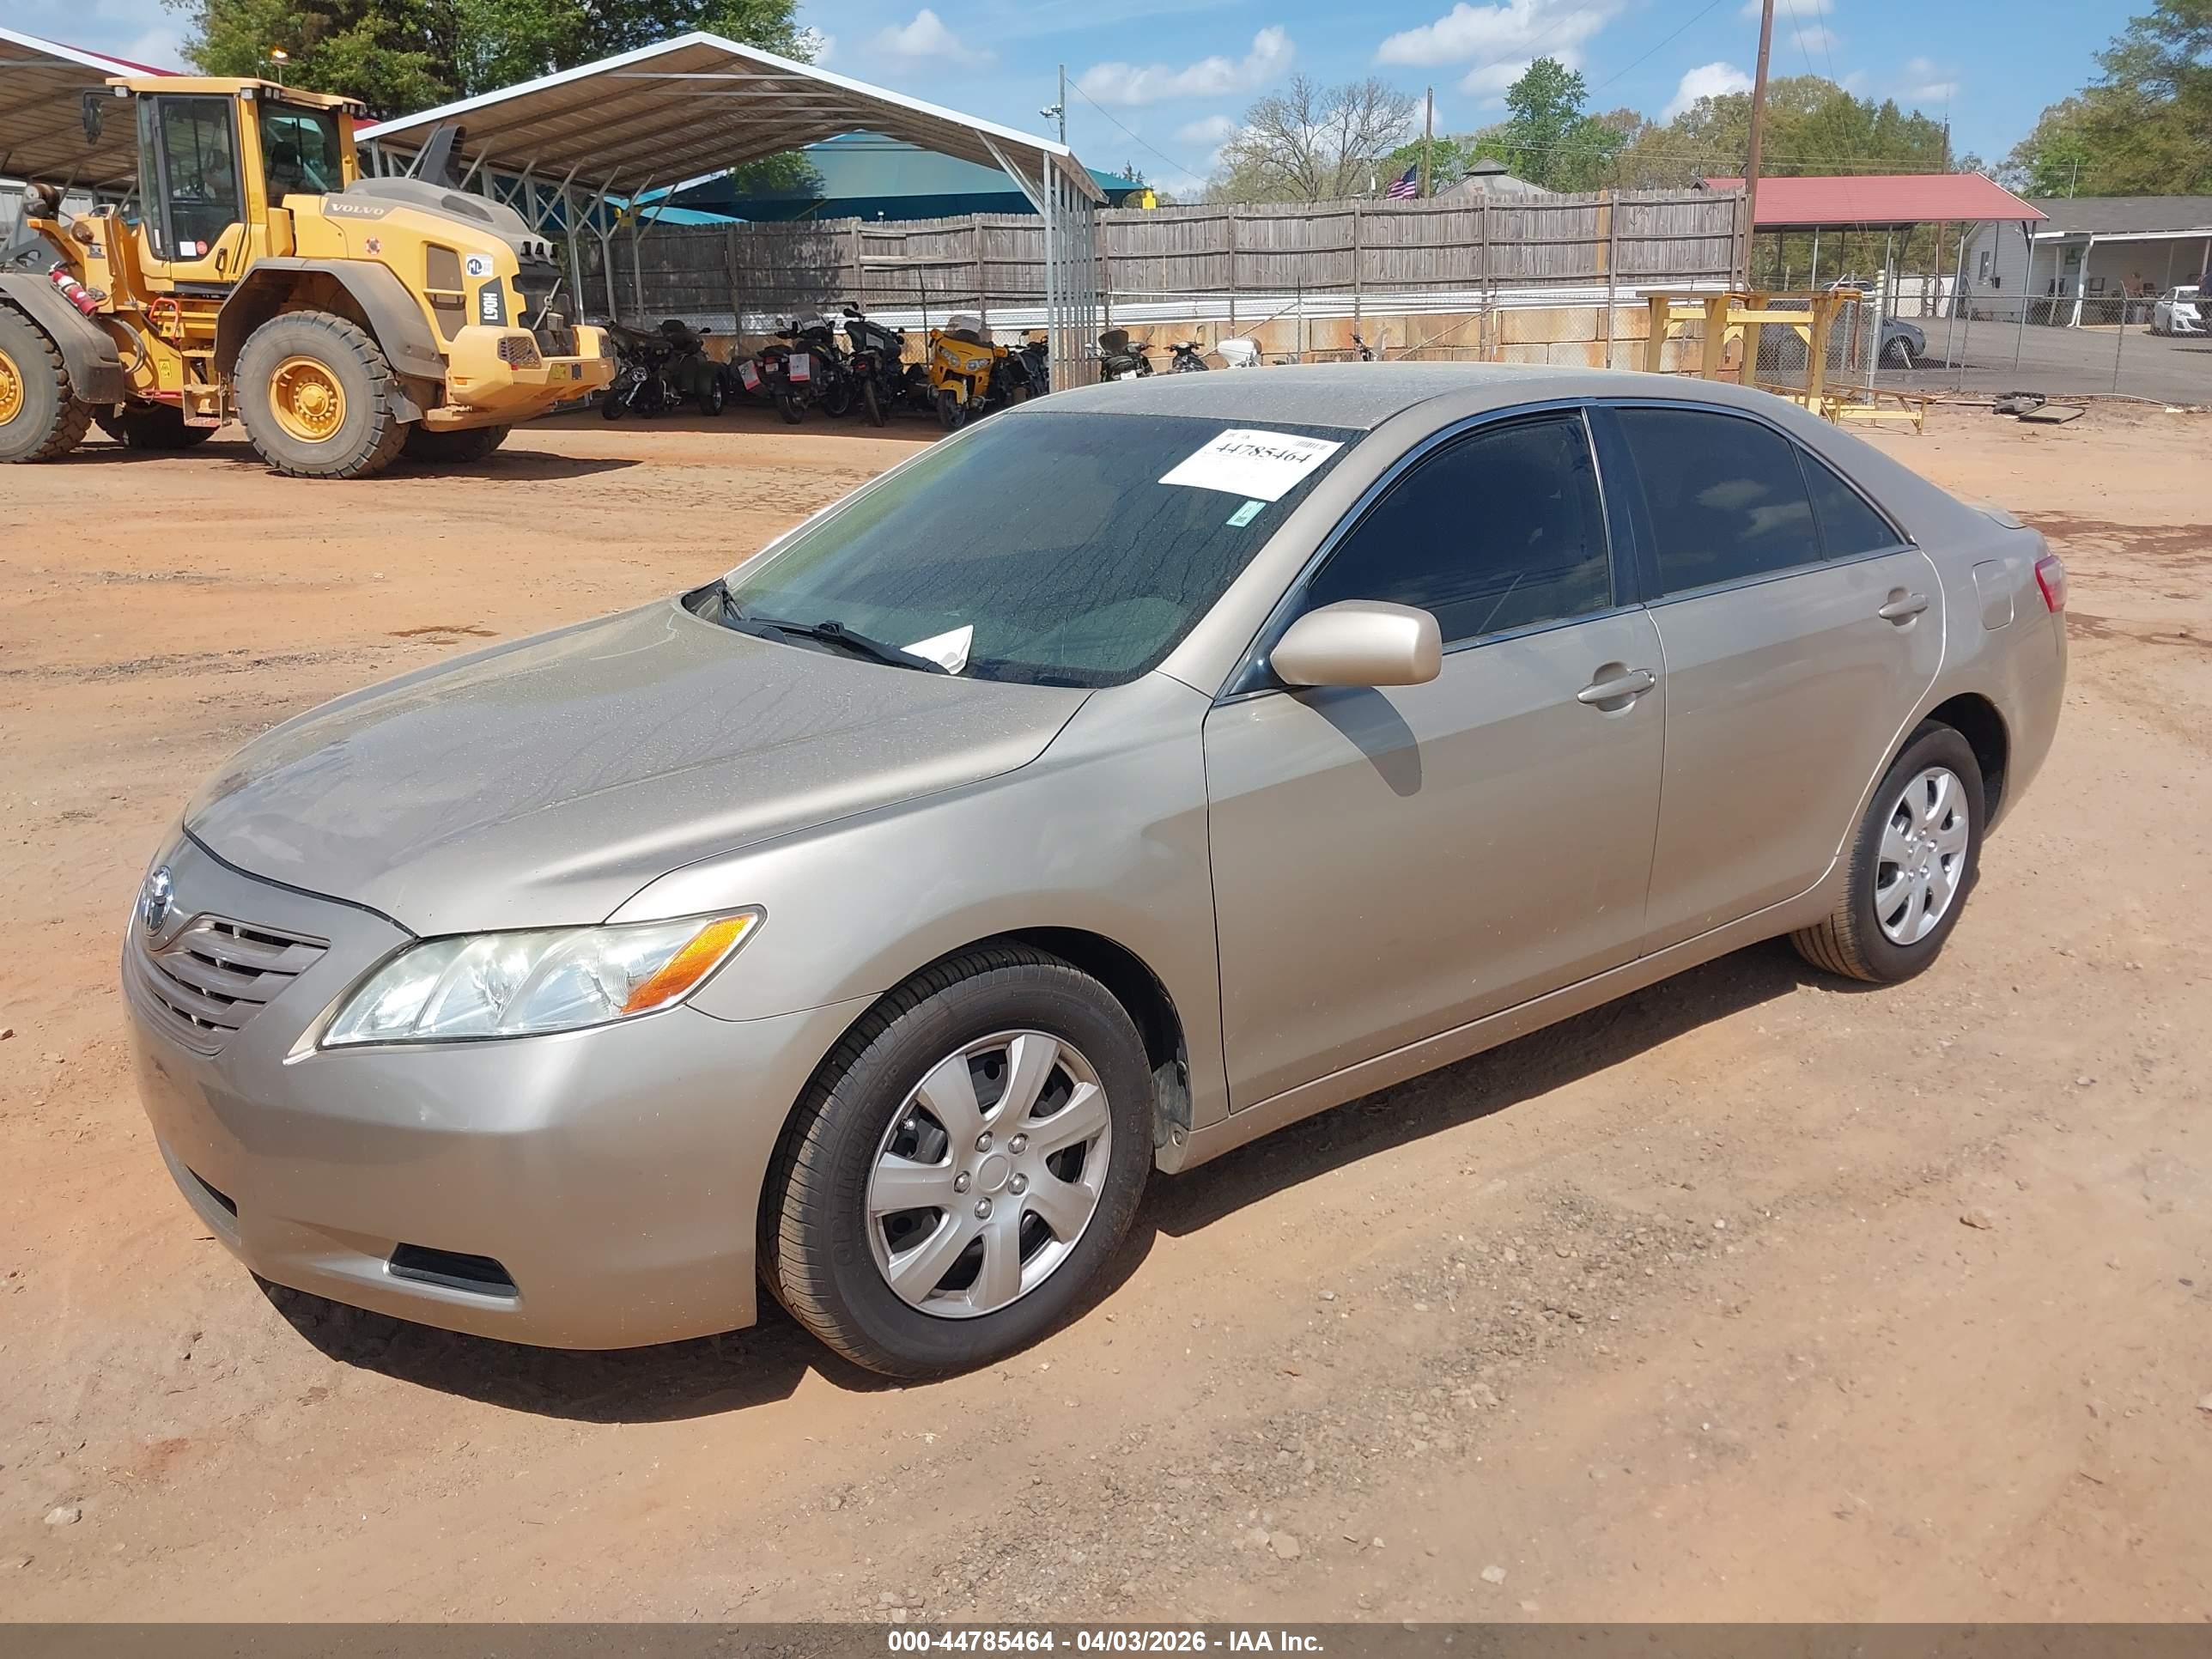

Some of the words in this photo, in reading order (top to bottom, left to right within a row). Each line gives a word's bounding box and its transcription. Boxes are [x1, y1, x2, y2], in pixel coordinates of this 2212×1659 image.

[331, 204, 385, 216] VOLVO
[483, 293, 498, 320] L90H
[1216, 443, 1312, 464] 44785464
